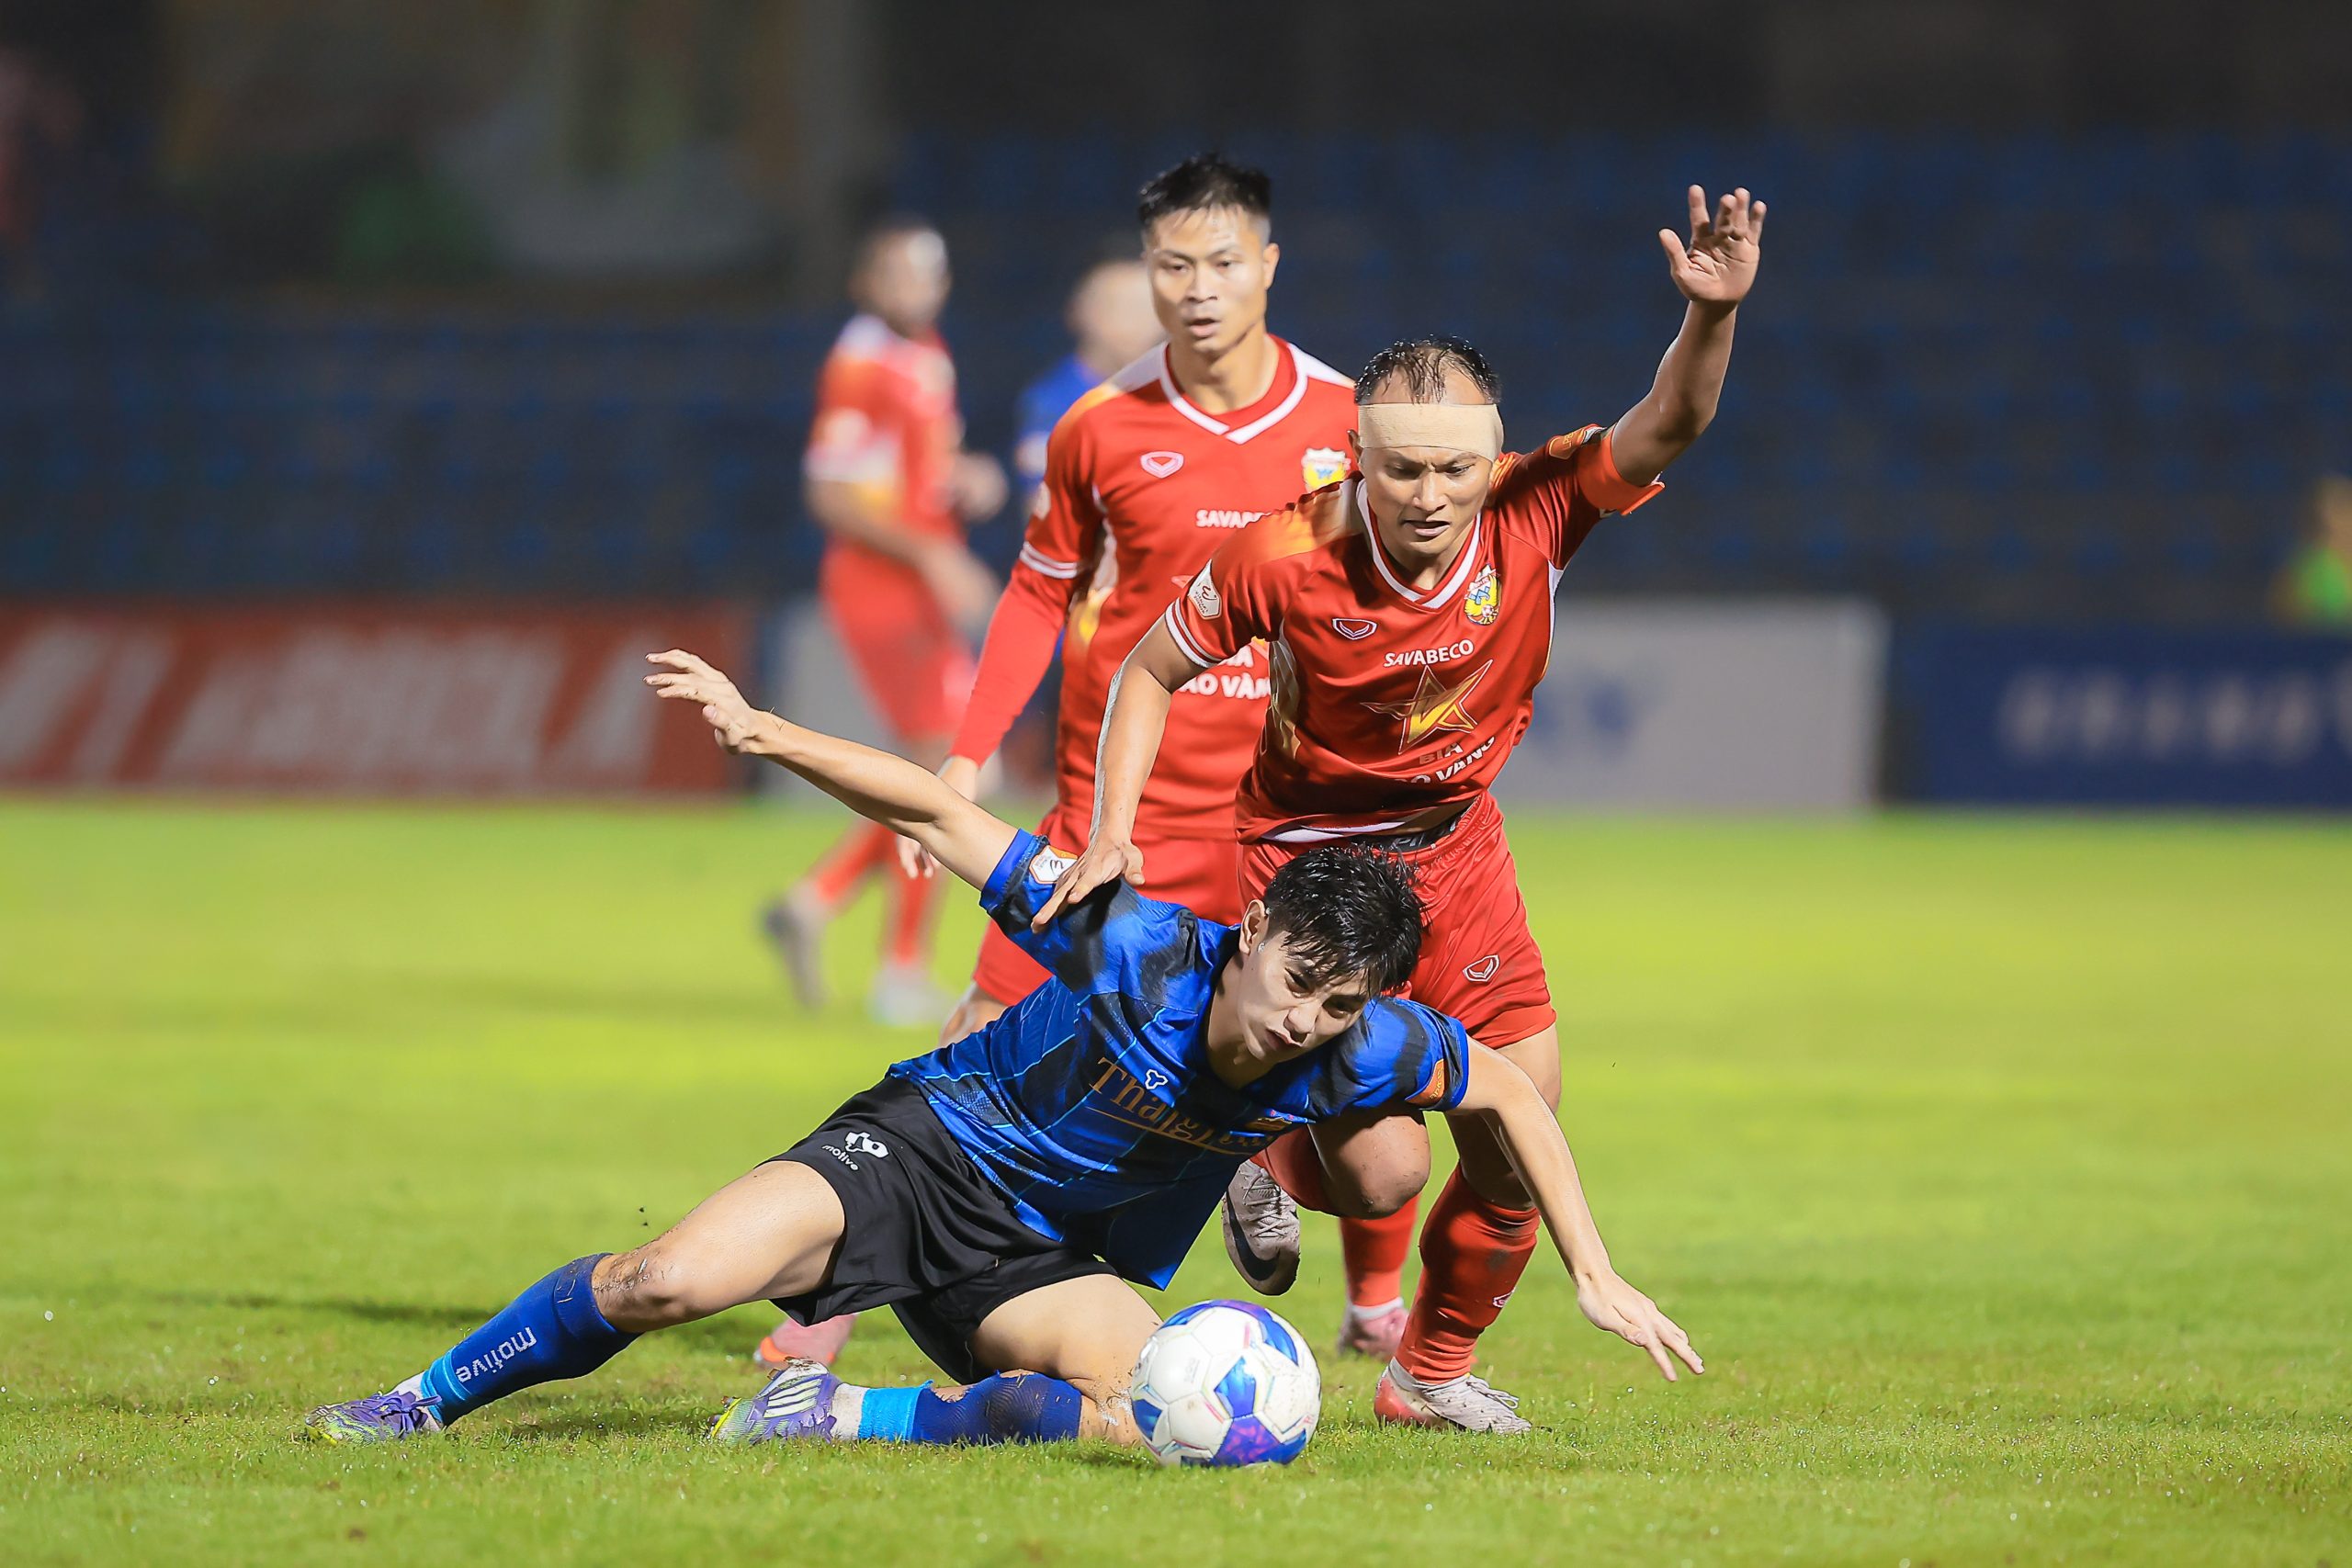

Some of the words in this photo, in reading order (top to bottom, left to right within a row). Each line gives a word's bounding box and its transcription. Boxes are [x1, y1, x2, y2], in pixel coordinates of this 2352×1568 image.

[1383, 638, 1475, 668] SAVABECO
[1419, 742, 1464, 765] BIA
[821, 1144, 859, 1171] motive
[455, 1325, 537, 1383] motive
